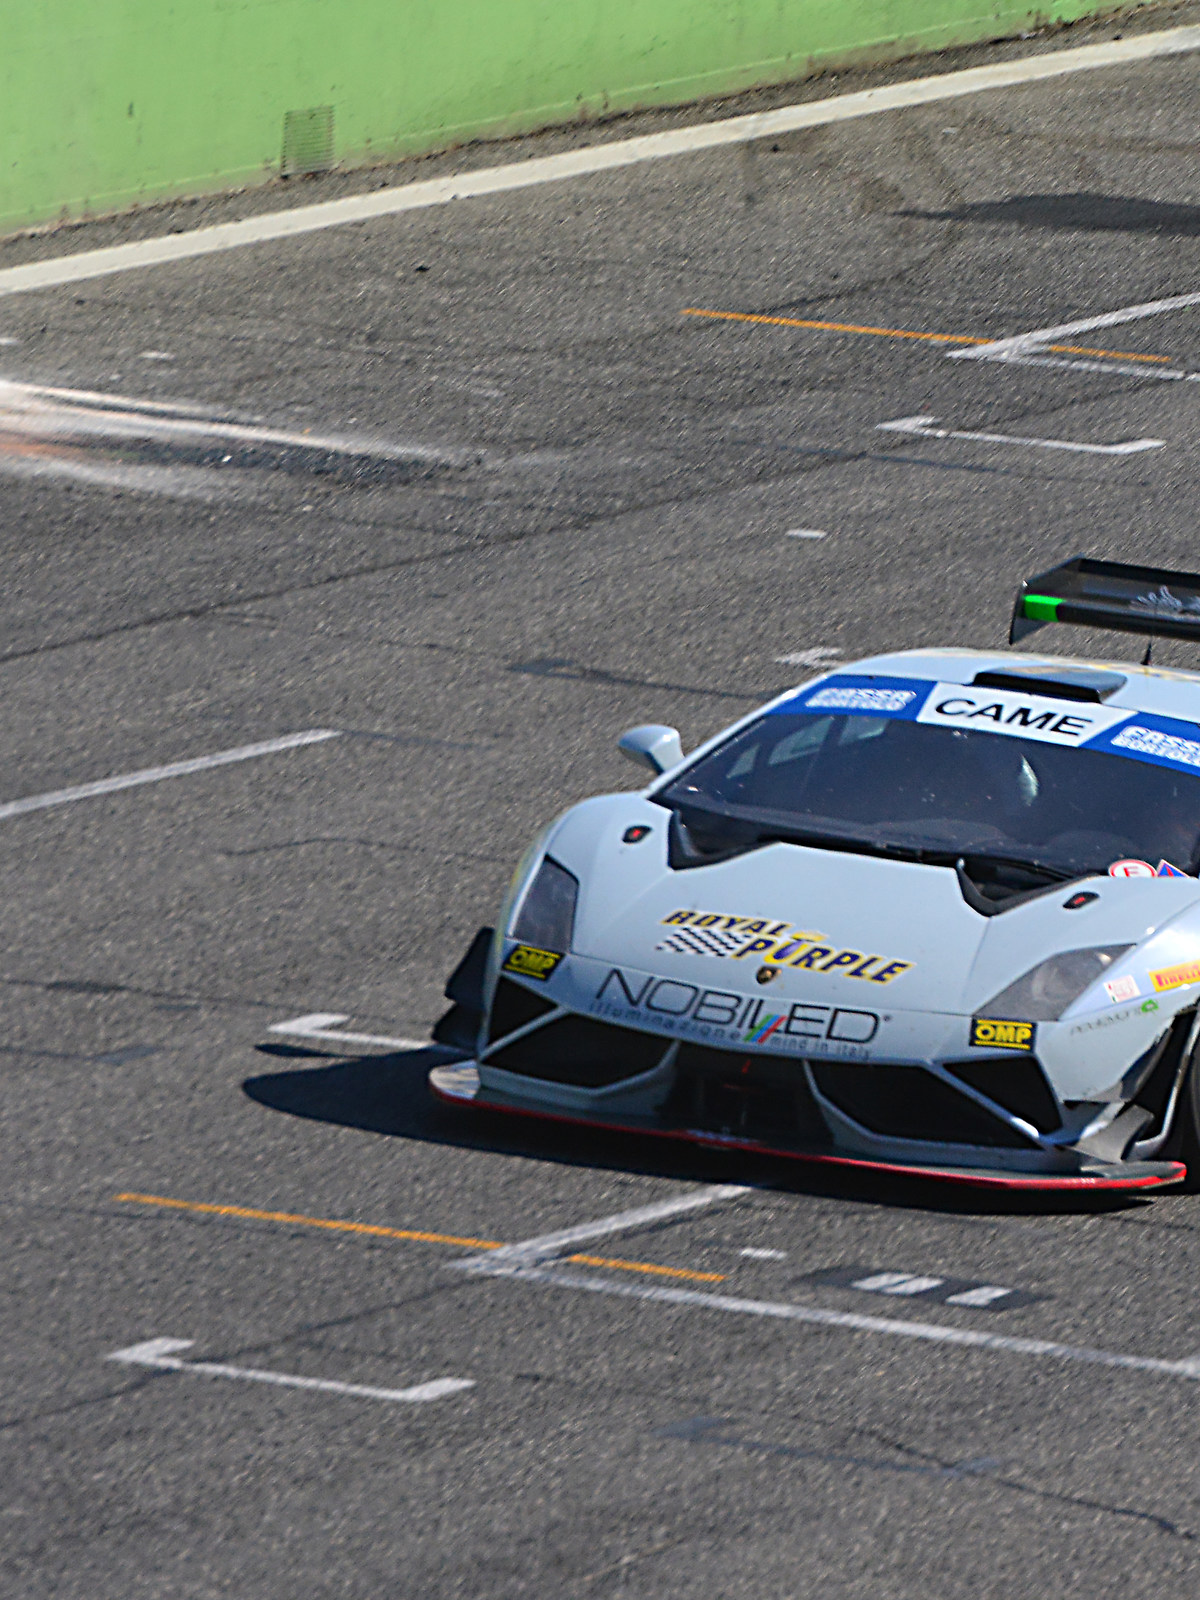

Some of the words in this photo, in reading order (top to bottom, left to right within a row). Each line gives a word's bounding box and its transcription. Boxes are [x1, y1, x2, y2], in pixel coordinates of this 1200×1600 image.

[935, 698, 1093, 737] CAME
[660, 909, 793, 937] ROYAL
[510, 950, 556, 972] OMP
[731, 934, 915, 985] PURPLE
[975, 1023, 1032, 1043] OMP
